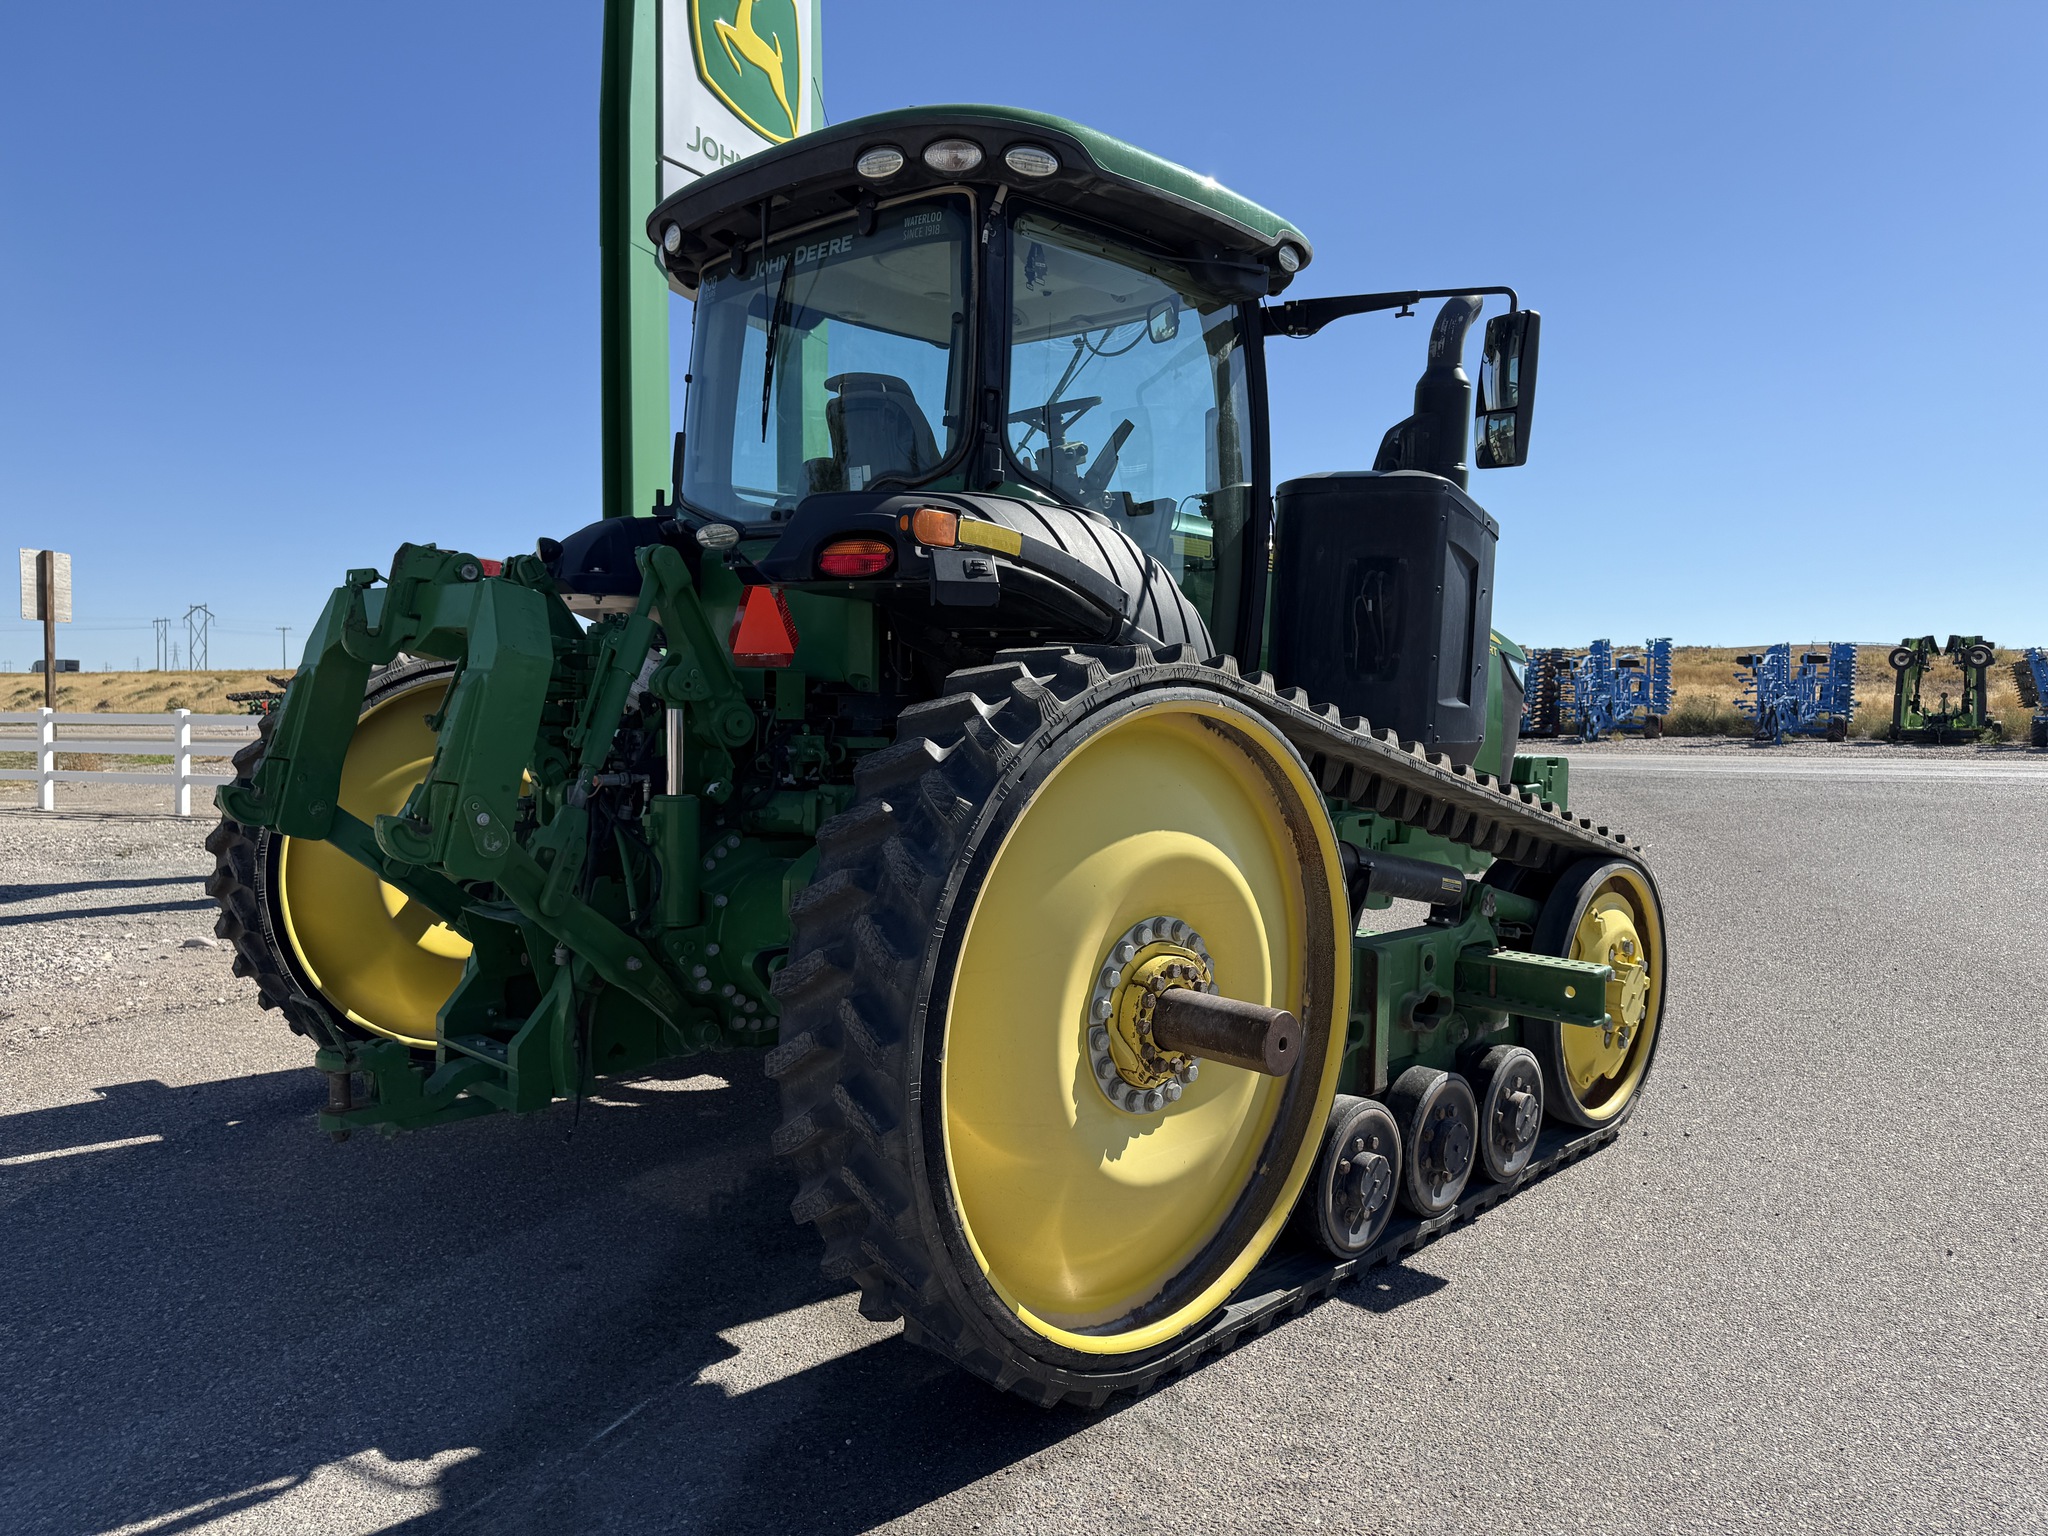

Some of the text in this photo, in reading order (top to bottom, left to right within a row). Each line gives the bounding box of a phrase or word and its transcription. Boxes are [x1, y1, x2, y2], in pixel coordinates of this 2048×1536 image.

[904, 211, 942, 228] WATERLOO
[903, 224, 941, 241] SINCE 1918
[794, 234, 853, 266] DEERE
